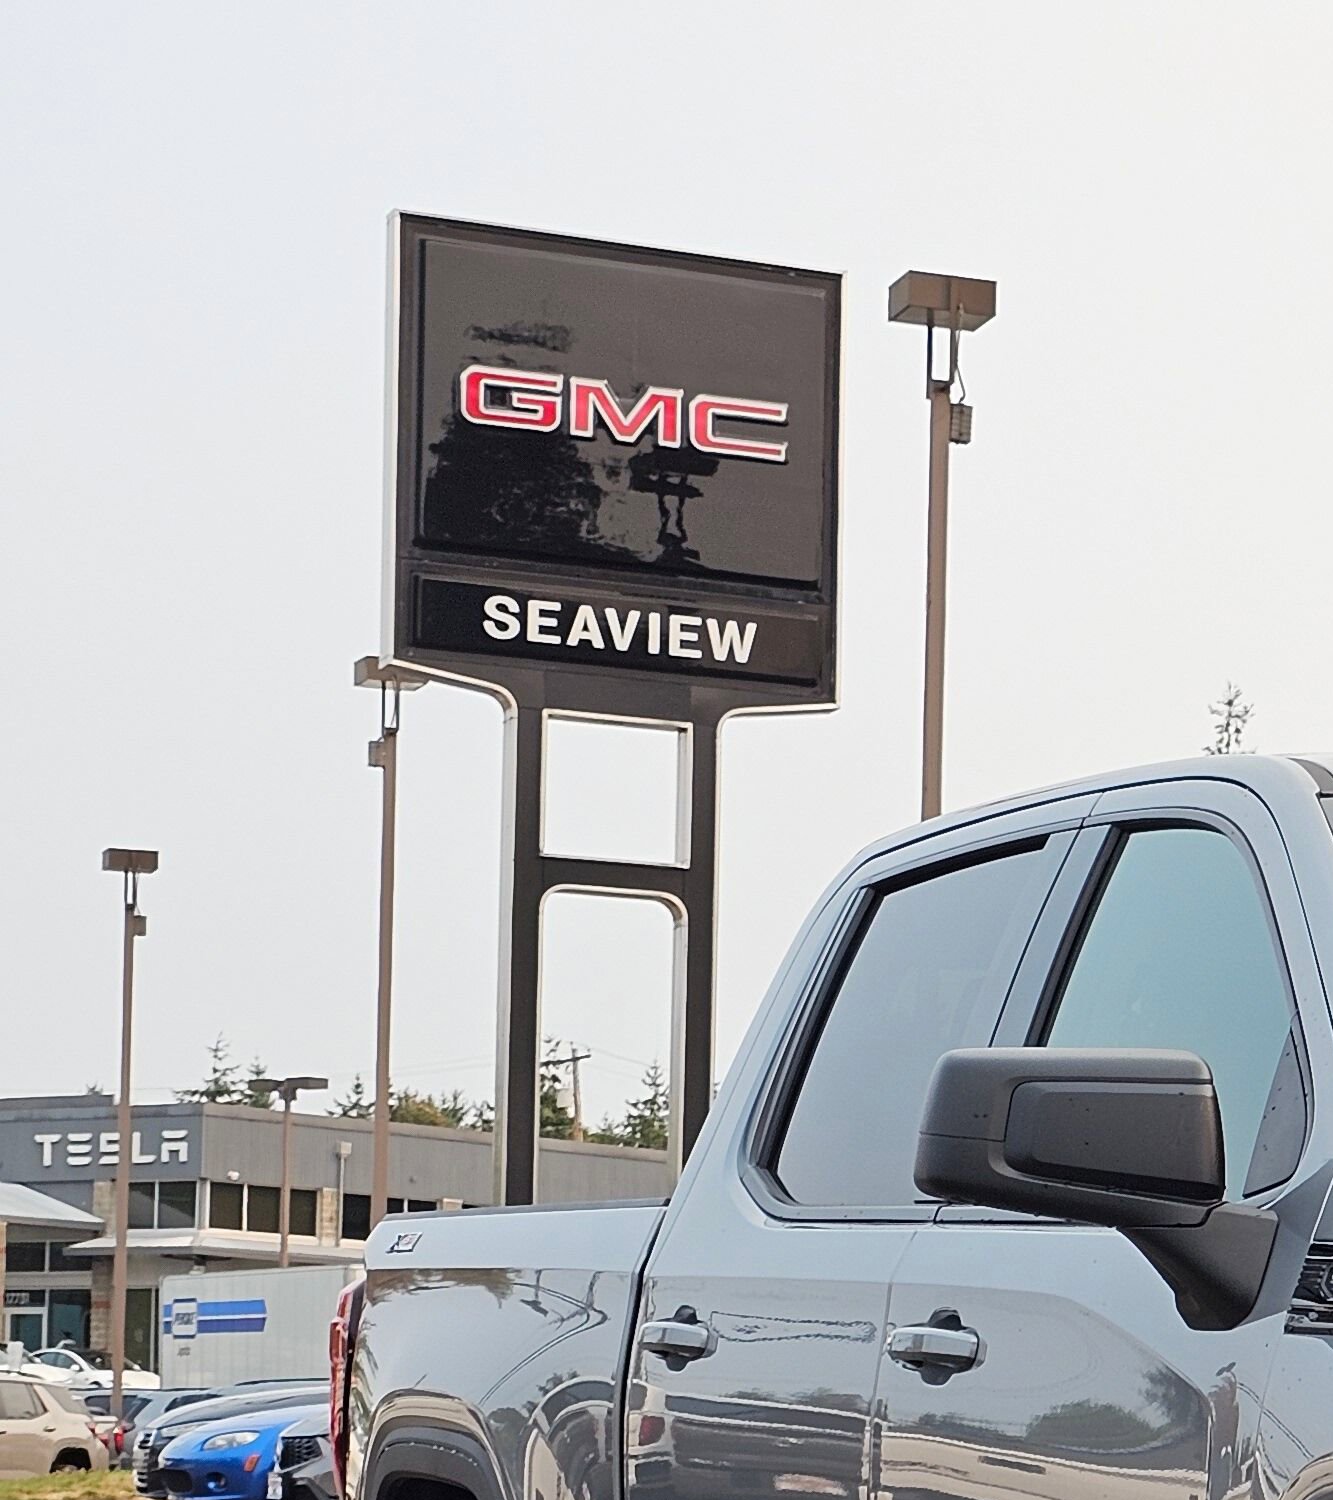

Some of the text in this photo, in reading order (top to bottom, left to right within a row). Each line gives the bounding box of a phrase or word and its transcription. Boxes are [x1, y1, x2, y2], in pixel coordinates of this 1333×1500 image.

[459, 363, 789, 463] GMC
[482, 594, 758, 665] SEAVIEW
[34, 1129, 188, 1167] TESLA
